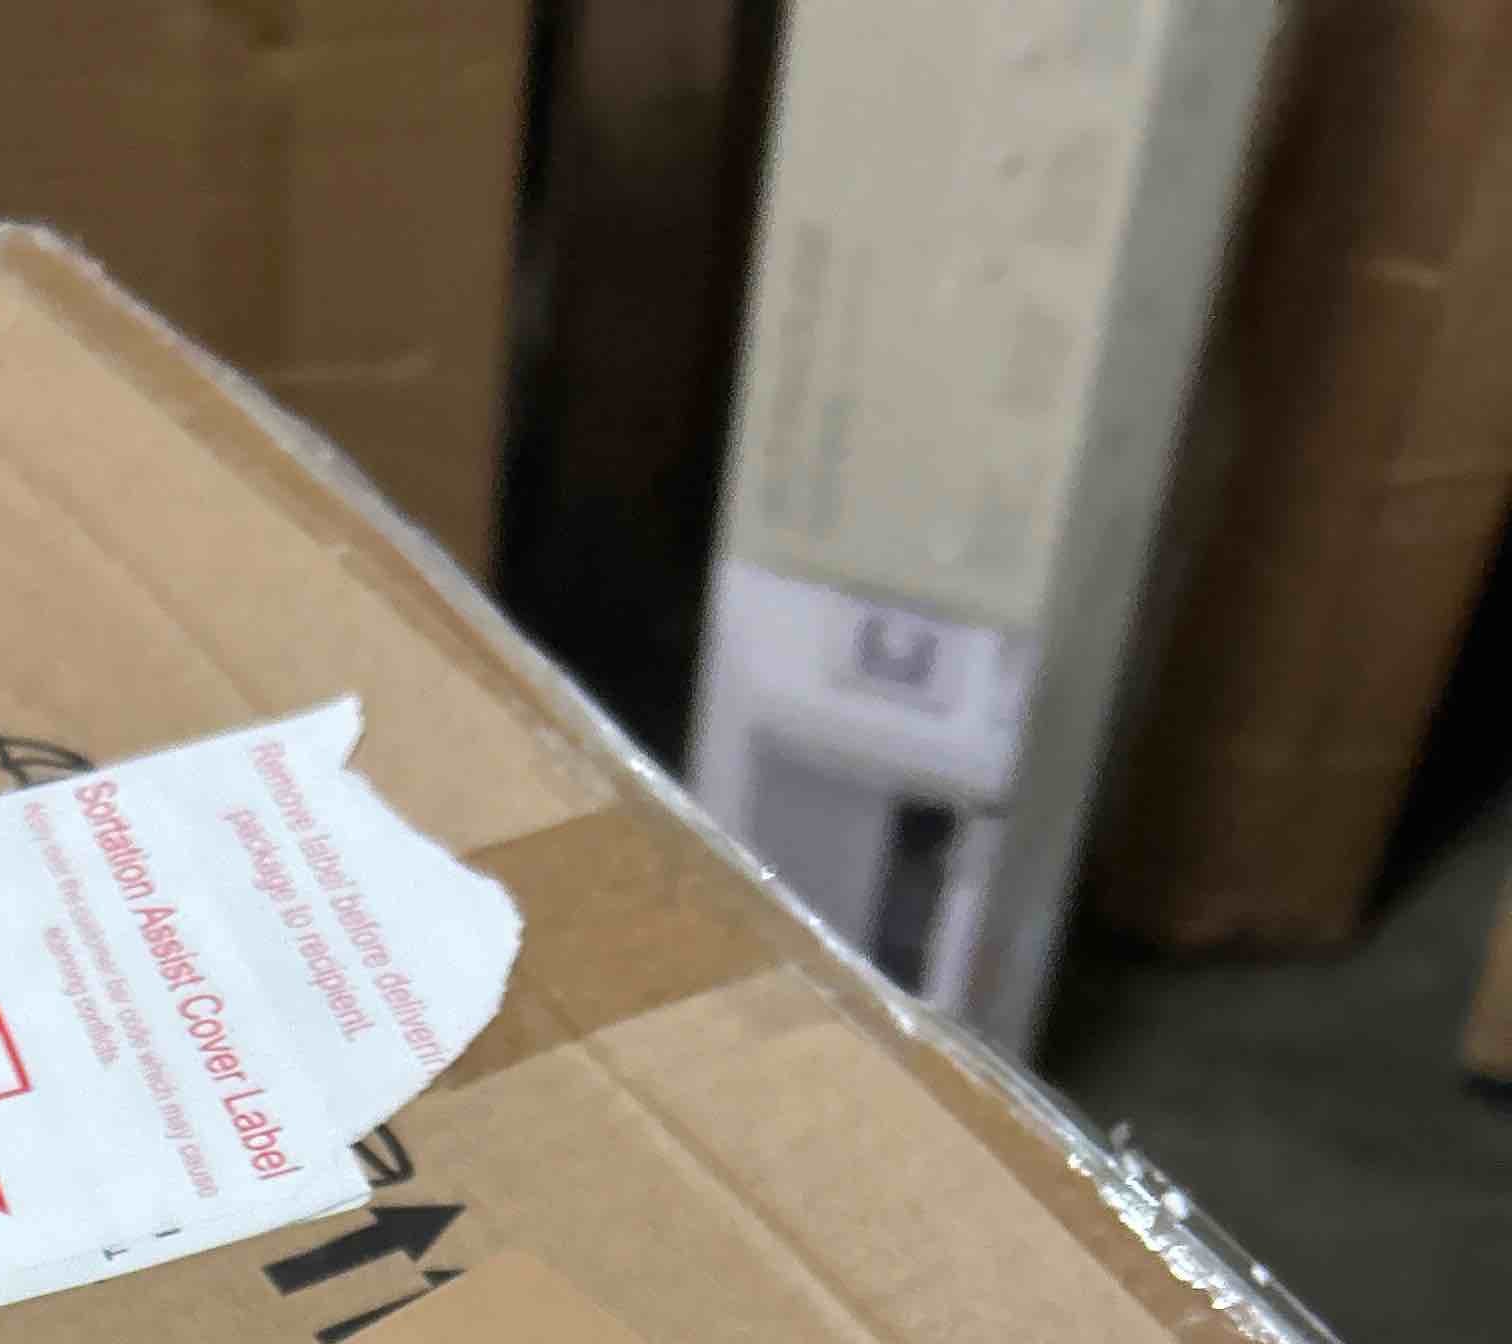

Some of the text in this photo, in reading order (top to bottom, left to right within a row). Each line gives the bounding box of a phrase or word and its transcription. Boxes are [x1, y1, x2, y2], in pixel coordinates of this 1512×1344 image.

[74, 778, 302, 1180] Sortation Assist Cover Label
